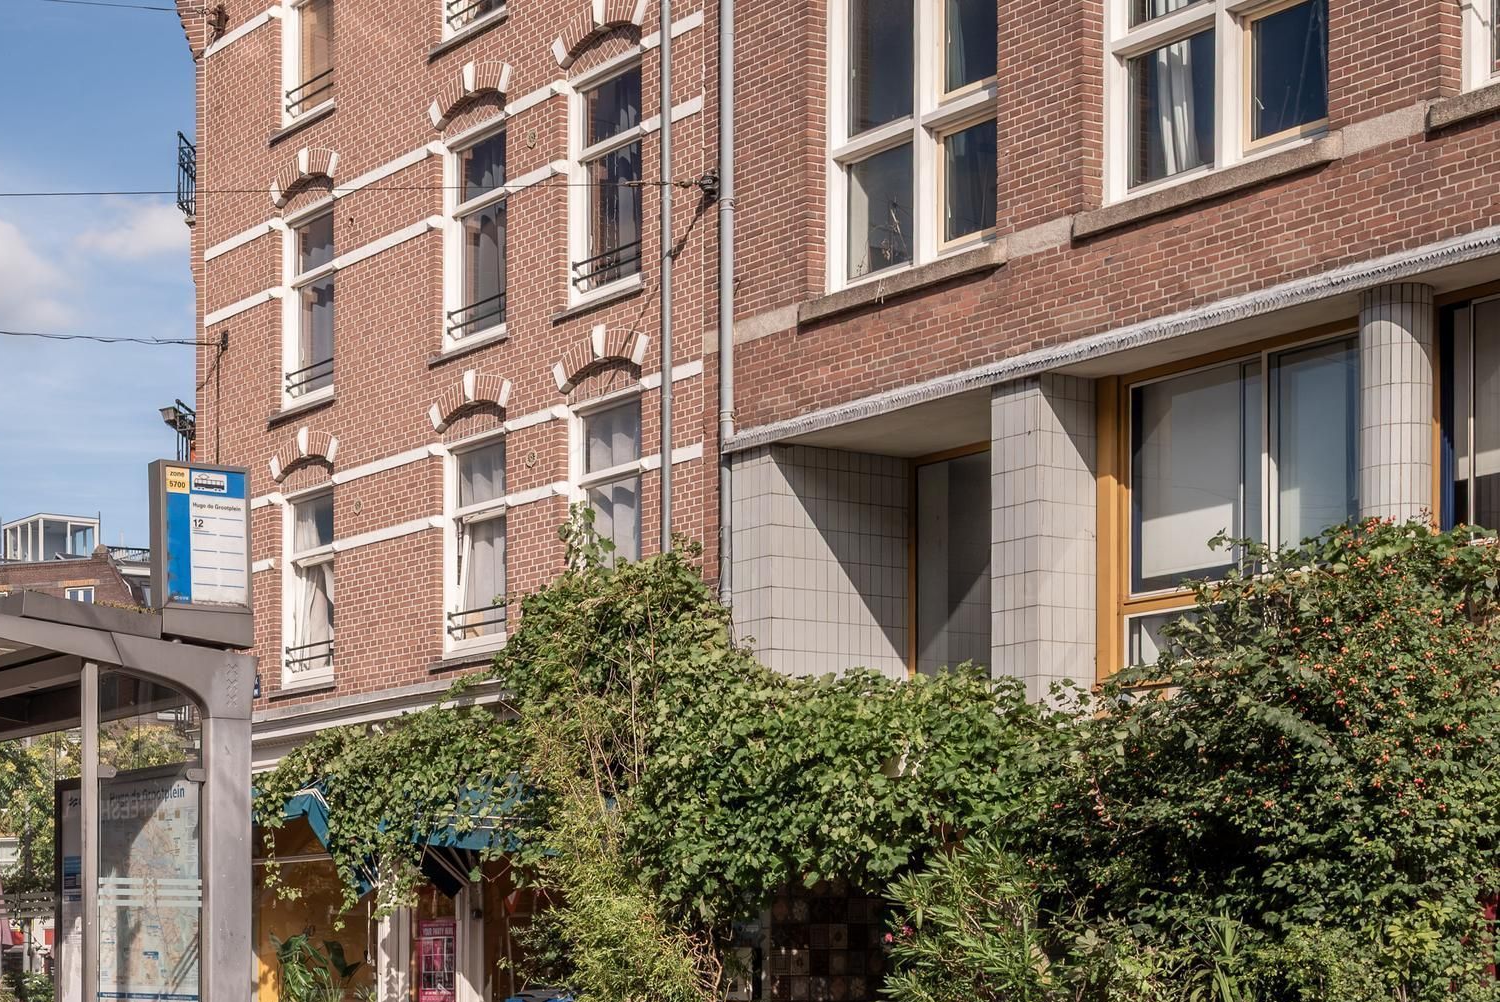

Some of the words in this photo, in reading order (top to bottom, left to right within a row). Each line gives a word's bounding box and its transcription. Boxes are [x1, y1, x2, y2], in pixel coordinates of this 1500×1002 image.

[169, 480, 186, 489] 5700
[215, 503, 242, 512] Grootplein
[194, 518, 204, 528] 12
